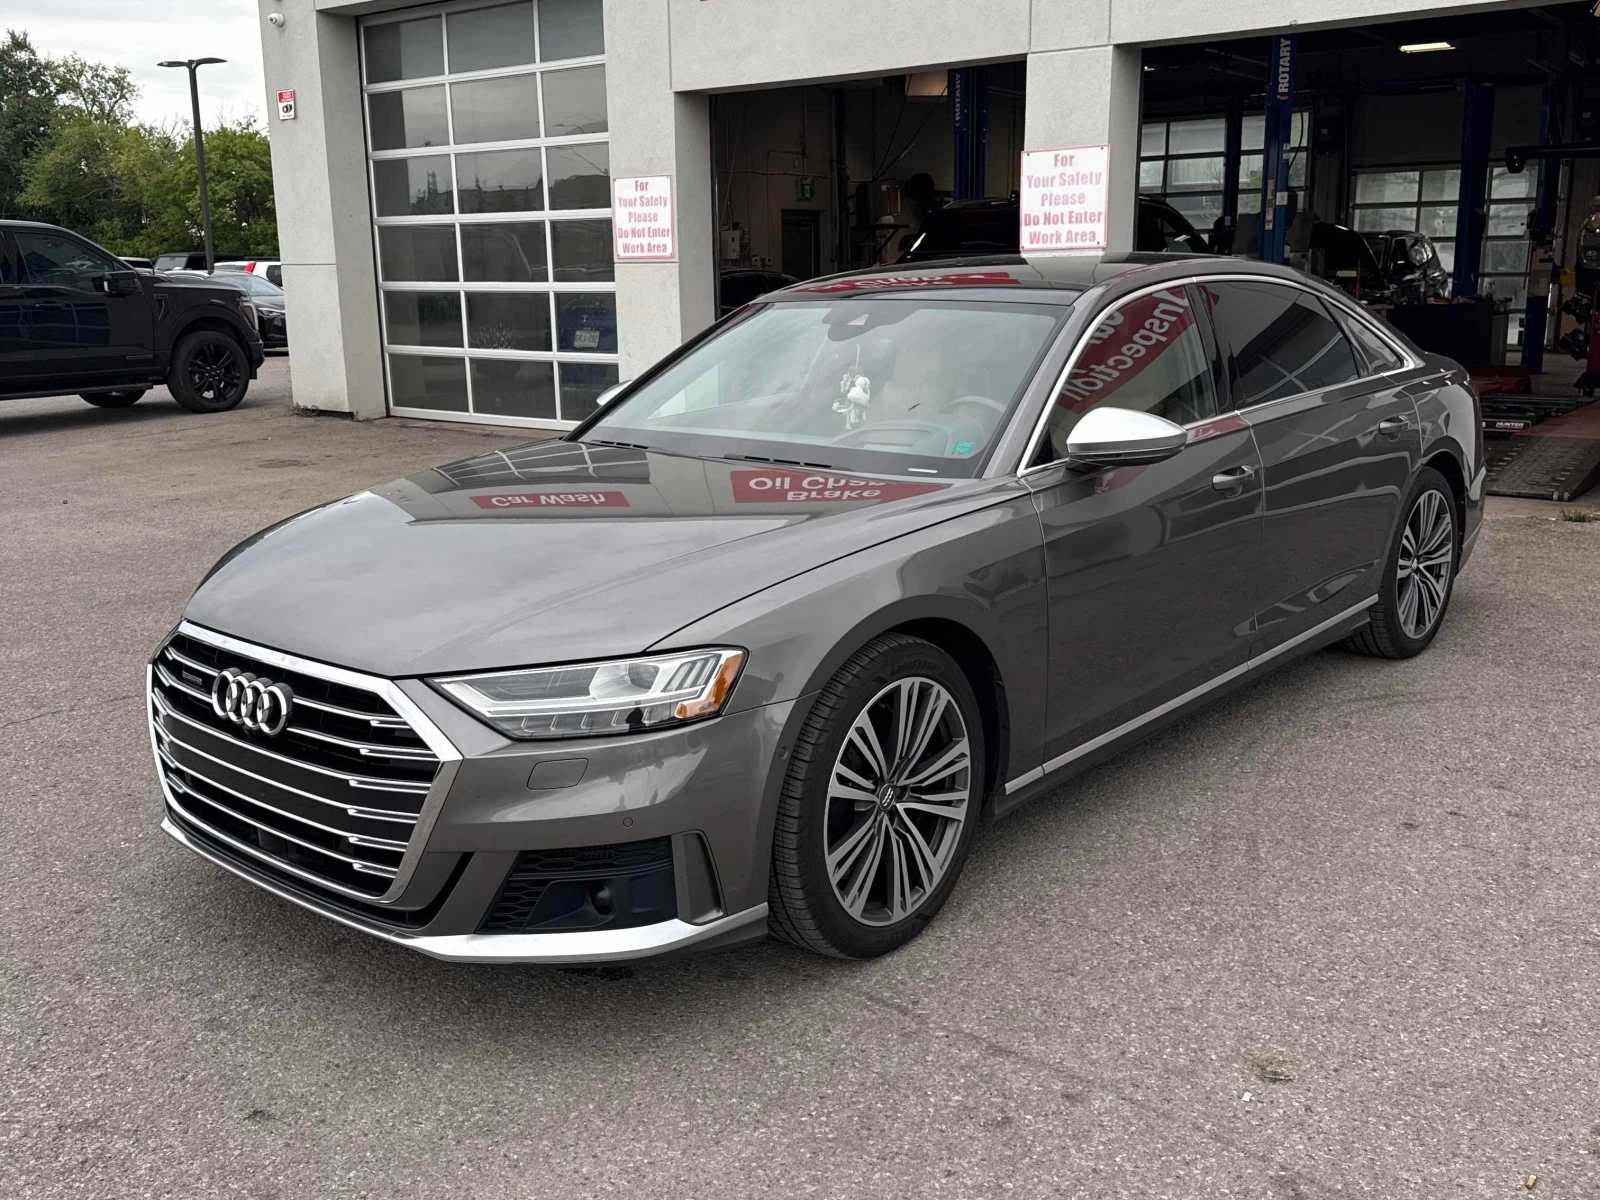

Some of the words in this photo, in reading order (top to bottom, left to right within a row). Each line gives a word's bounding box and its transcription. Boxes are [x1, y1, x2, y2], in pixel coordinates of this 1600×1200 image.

[1278, 38, 1291, 93] ROTARY
[1053, 153, 1075, 168] For
[634, 180, 649, 192] For
[1026, 174, 1056, 189] Your
[1058, 170, 1102, 187] Safety
[617, 196, 638, 208] Your
[639, 195, 668, 207] Safety
[1040, 192, 1086, 207] Please
[628, 211, 658, 223] Please
[1023, 213, 1040, 227] Do
[1043, 211, 1065, 226] Not
[1068, 210, 1103, 225] Enter
[617, 227, 629, 239] Do
[630, 227, 645, 238] Not
[647, 226, 670, 238] Enter
[1028, 230, 1062, 245] Work
[1065, 229, 1096, 243] Area
[622, 242, 645, 254] Work
[647, 242, 667, 253] Area
